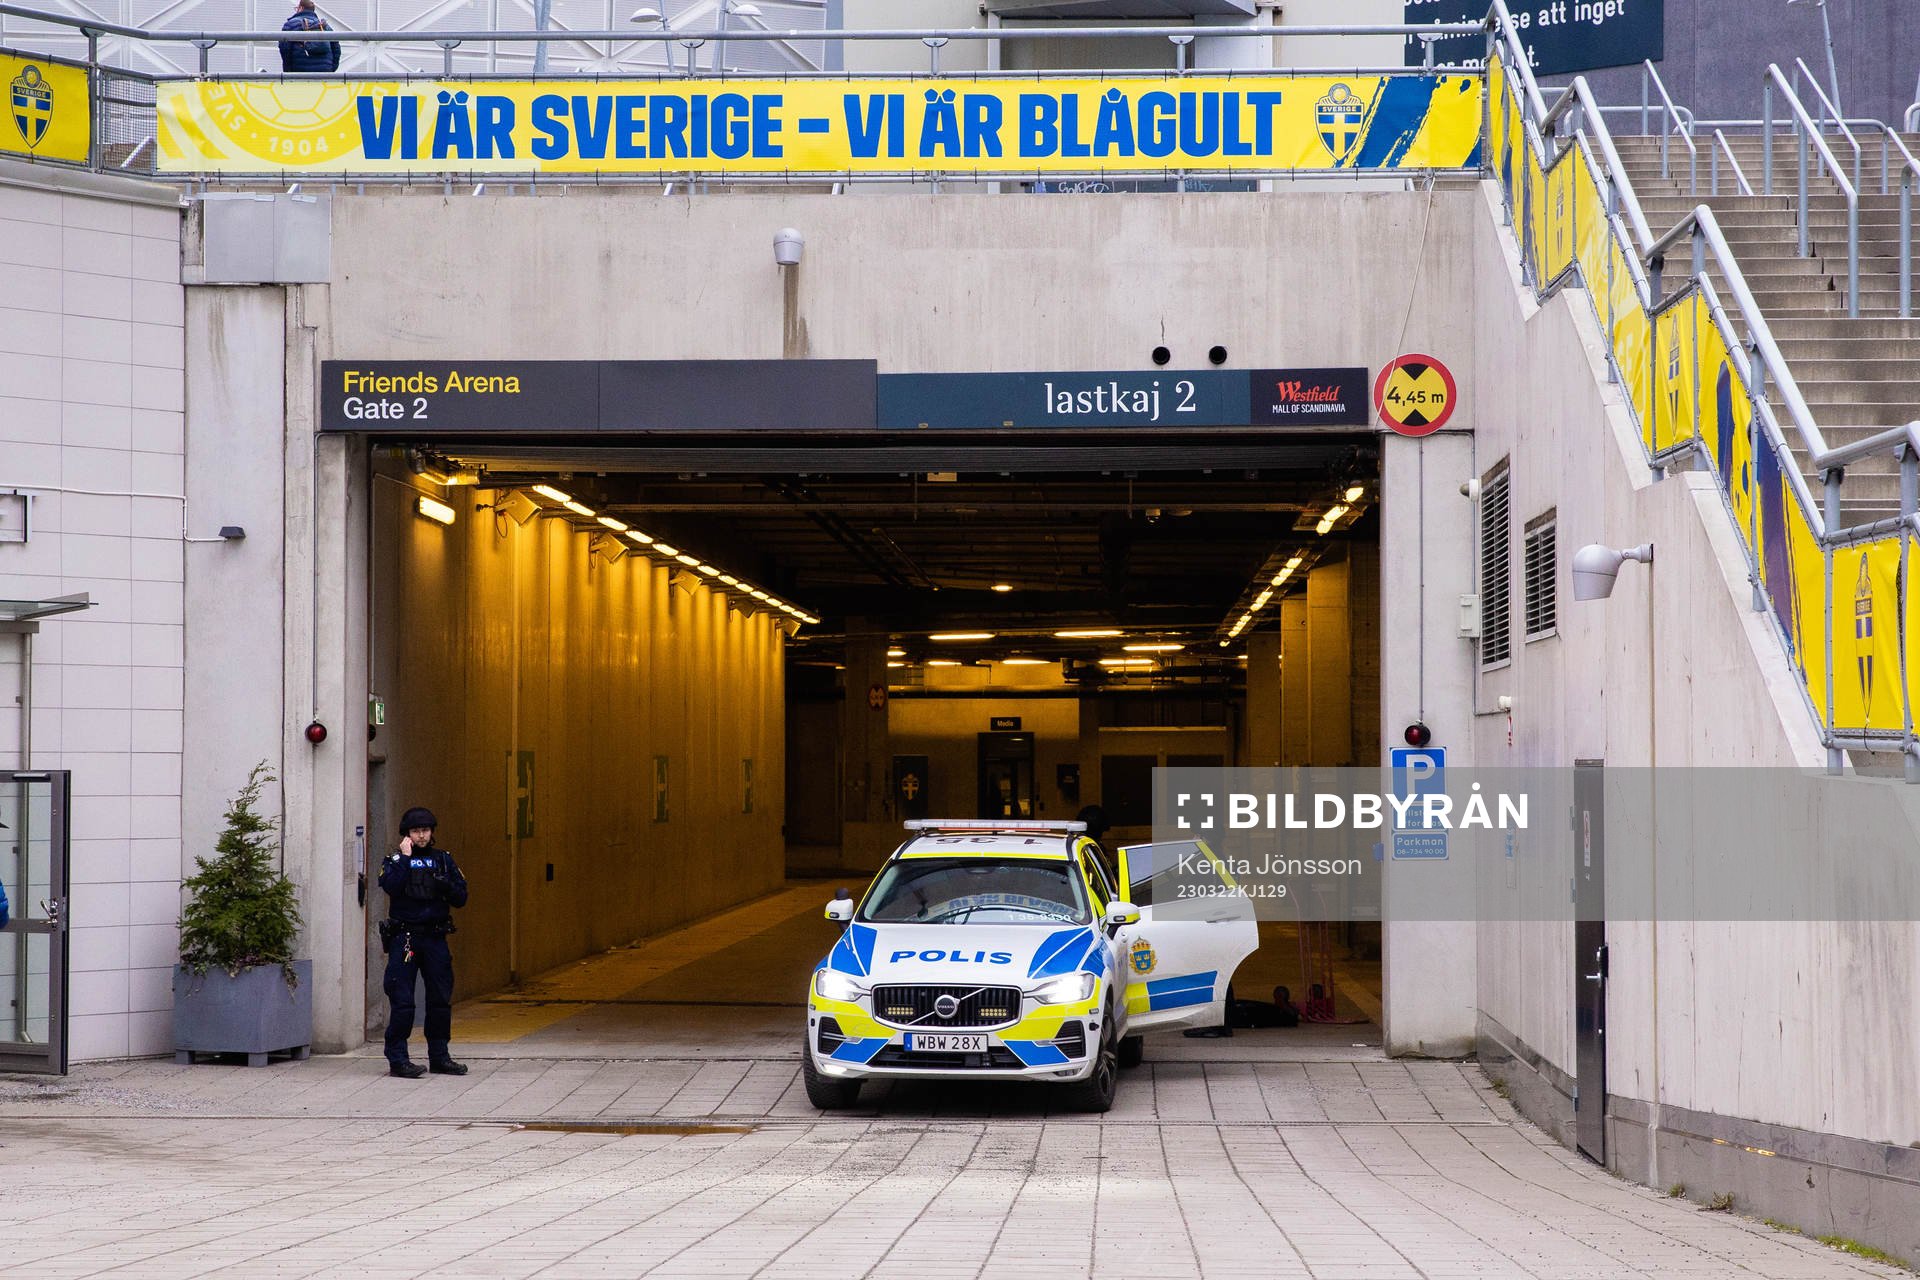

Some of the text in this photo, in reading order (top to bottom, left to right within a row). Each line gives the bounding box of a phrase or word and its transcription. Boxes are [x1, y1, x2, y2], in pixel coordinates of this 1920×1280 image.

[1538, 0, 1626, 27] att inget
[356, 95, 418, 160] VI
[432, 90, 515, 160] ÄR
[531, 94, 784, 160] SVERIGE
[843, 94, 905, 159] VI
[919, 88, 1001, 159] ÄR
[1019, 87, 1282, 158] BLÅGULT
[268, 136, 329, 156] 1904
[343, 371, 521, 393] Friends Arena
[1276, 381, 1341, 402] Westfield
[1044, 380, 1196, 421] lastkaj 2
[1387, 386, 1444, 406] 4,45 m
[343, 397, 428, 419] Gate 2
[1272, 403, 1346, 414] MALL OF SCANDINAVIA
[1406, 754, 1436, 797] P
[1396, 837, 1444, 846] Parkman
[889, 950, 1013, 965] POLIS
[917, 1036, 981, 1050] WBW 28X
